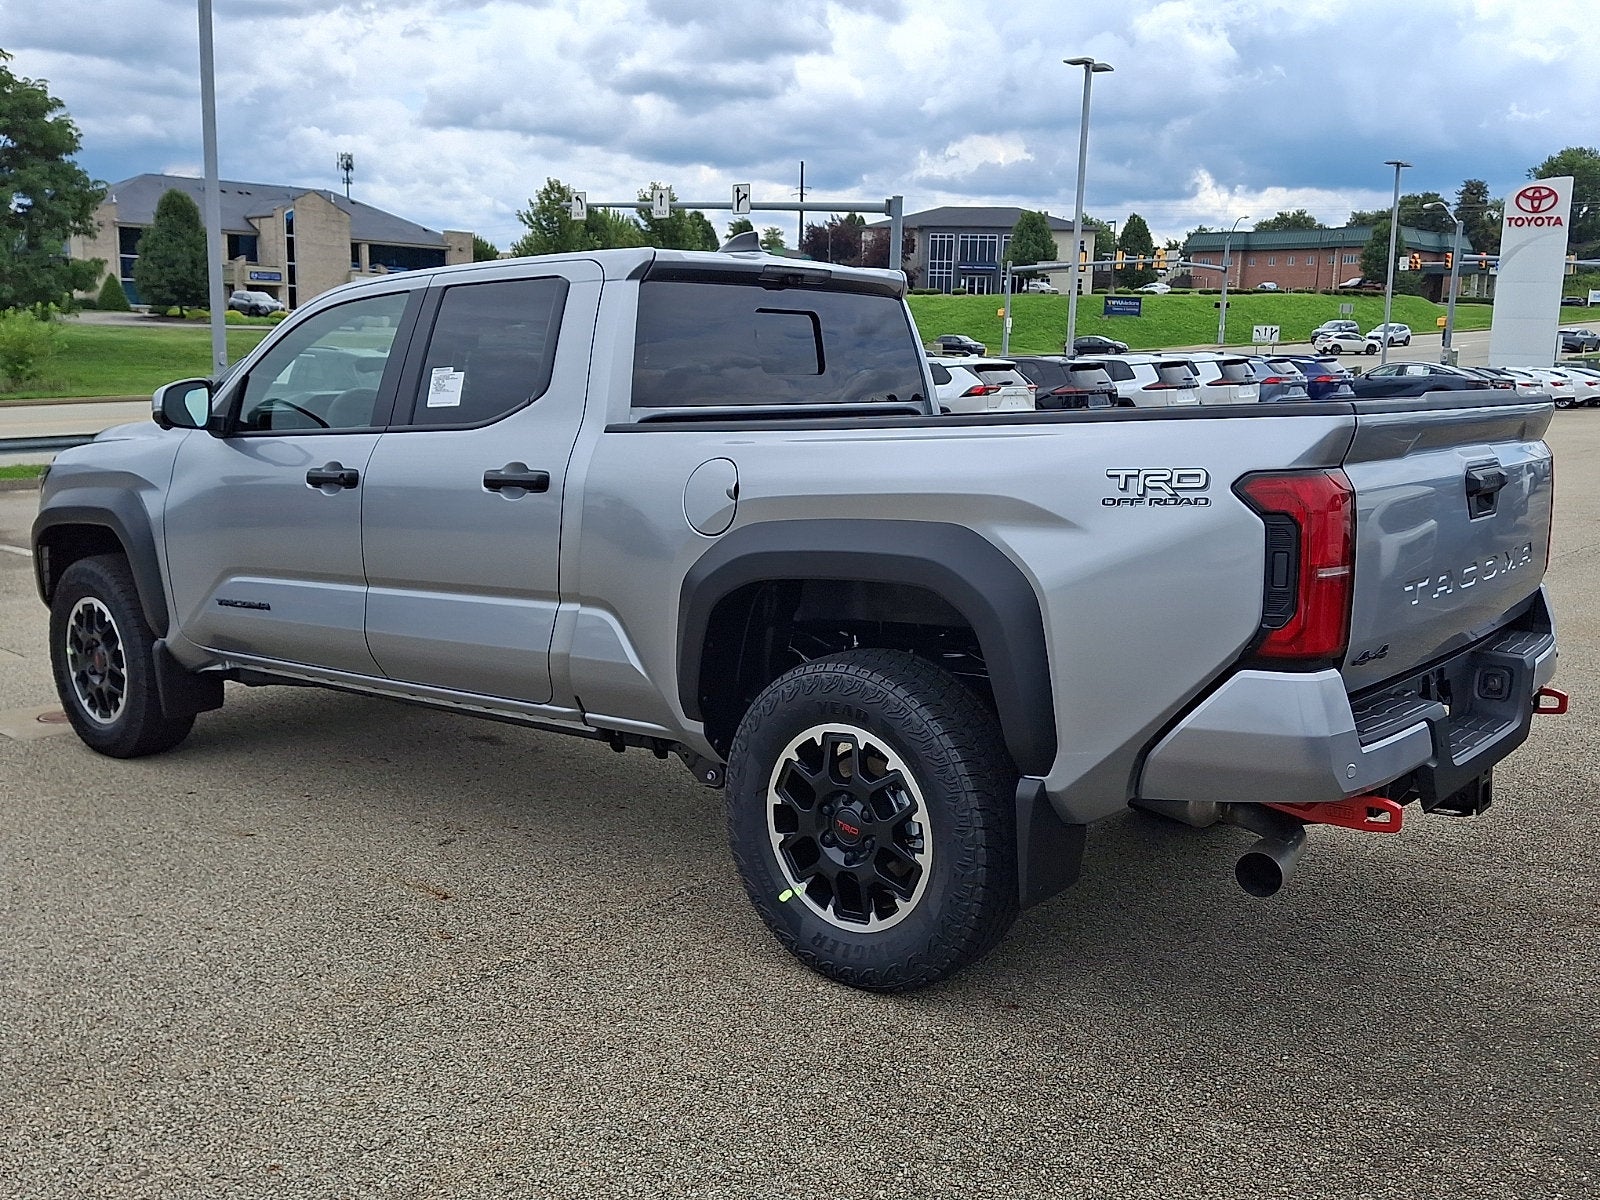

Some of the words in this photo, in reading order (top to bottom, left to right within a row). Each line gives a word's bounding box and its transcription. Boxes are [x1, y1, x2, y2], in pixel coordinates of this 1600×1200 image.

[1506, 216, 1563, 227] TOYOTA
[1106, 468, 1210, 497] TRD
[1102, 498, 1145, 507] OFF
[1149, 497, 1211, 507] ROAD
[1403, 542, 1532, 605] TACOMA
[215, 598, 271, 610] TACOMA
[836, 819, 860, 835] TRD
